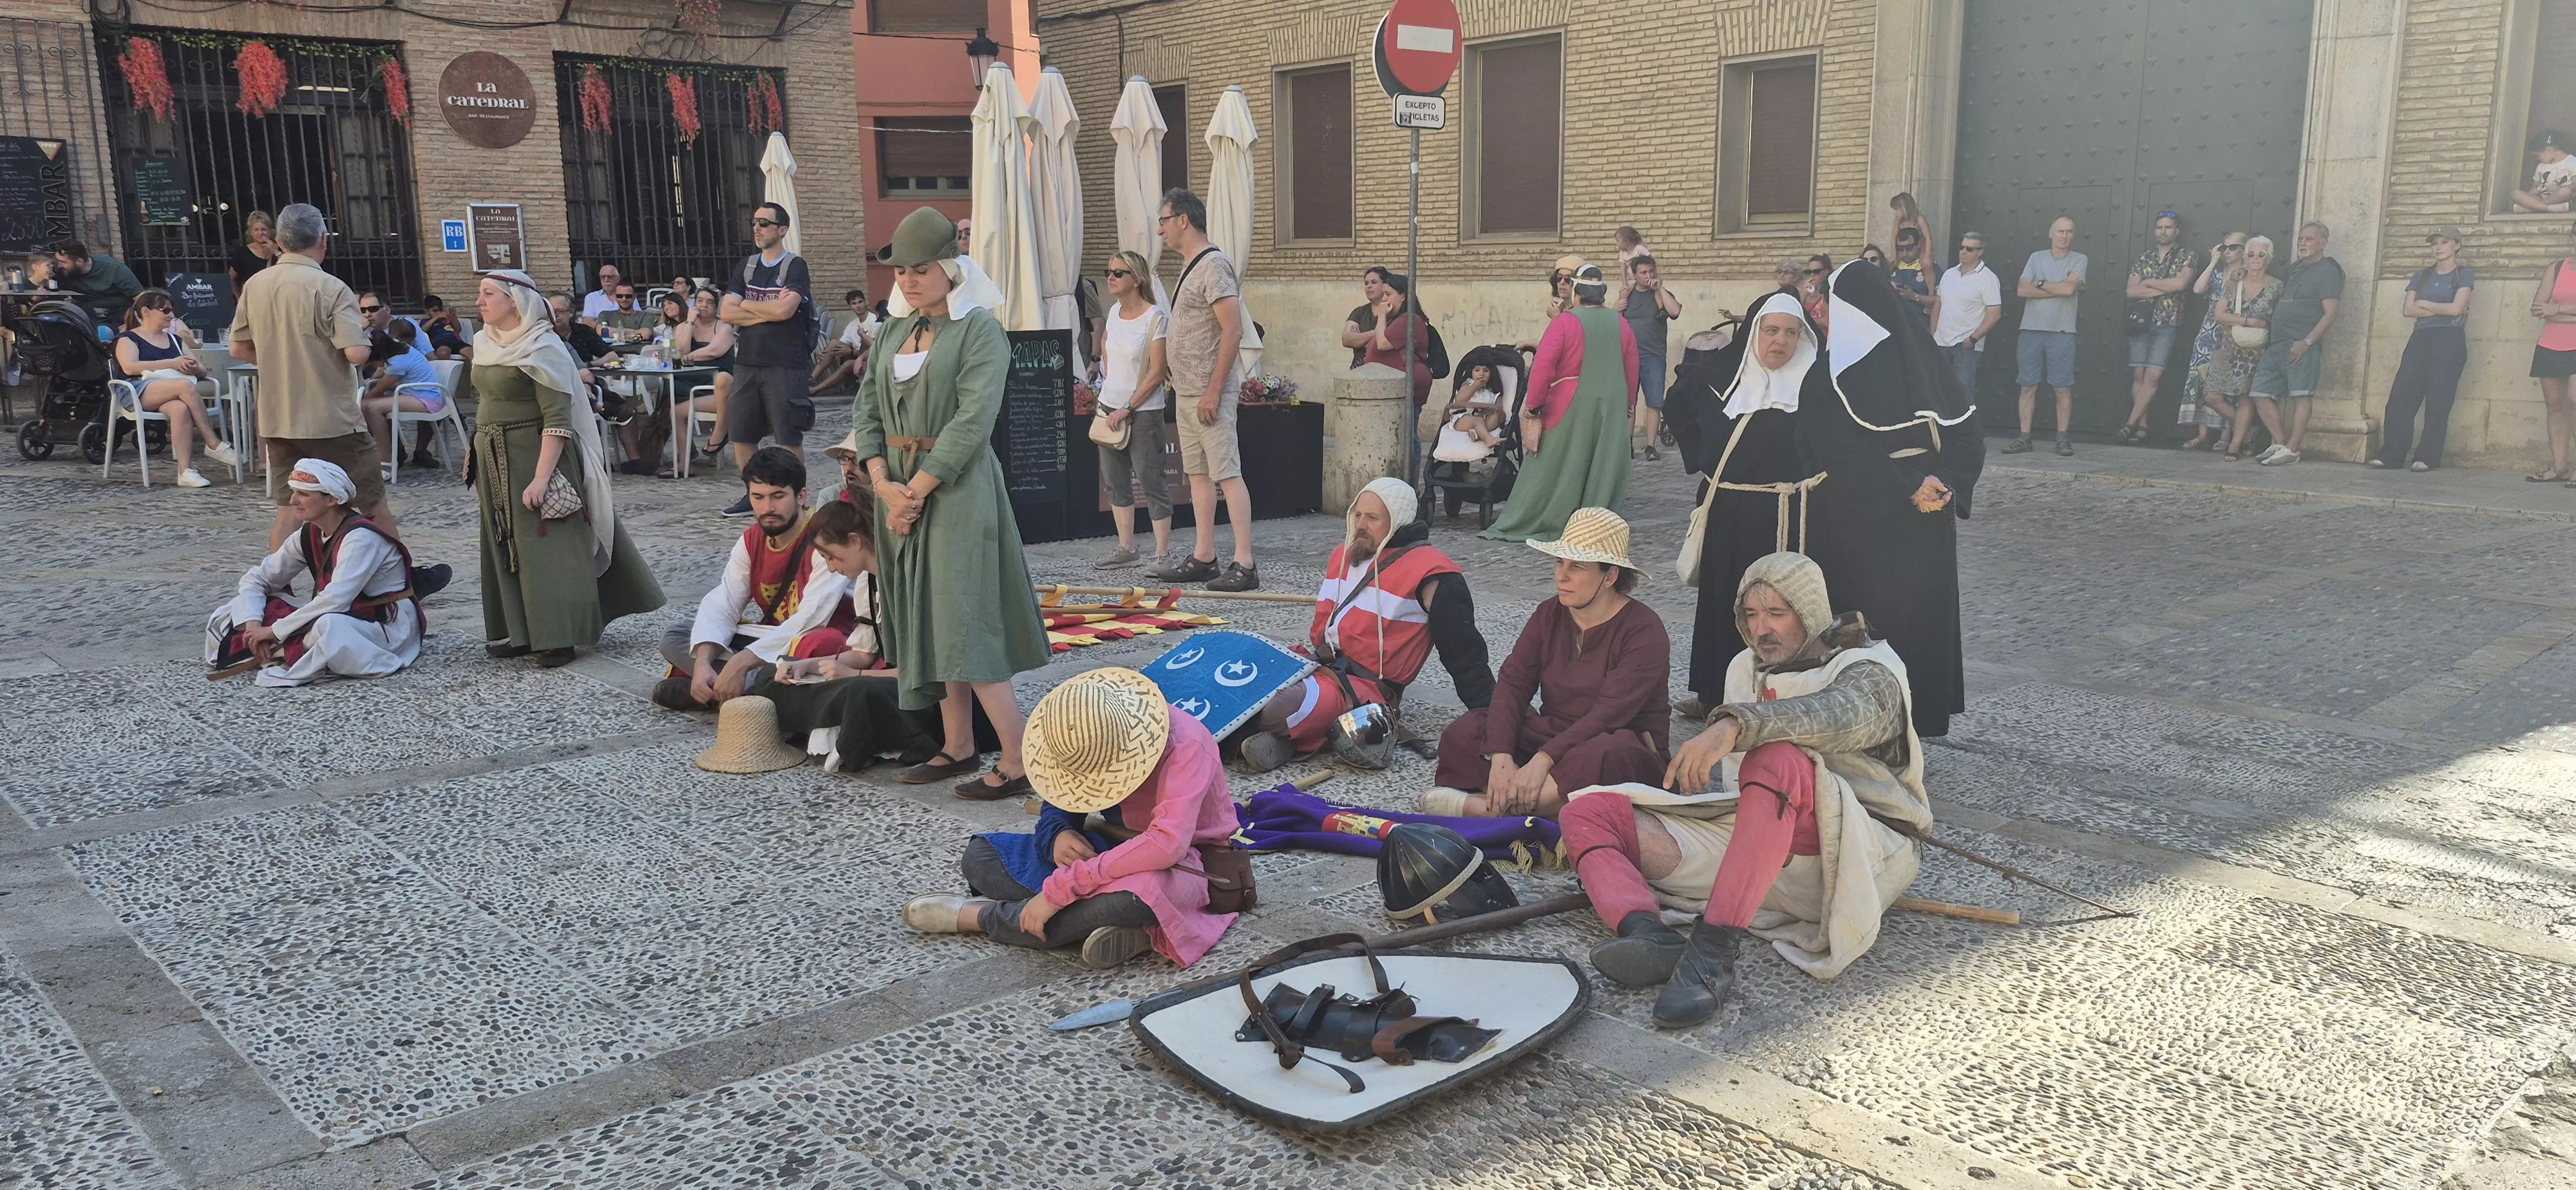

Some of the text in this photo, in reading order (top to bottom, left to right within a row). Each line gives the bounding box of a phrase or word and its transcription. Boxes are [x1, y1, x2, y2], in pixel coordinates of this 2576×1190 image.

[1405, 101, 1436, 110] EXCEPTO
[1410, 113, 1439, 122] ICLETAS
[446, 225, 463, 237] RB
[1012, 339, 1060, 369] TAPAS
